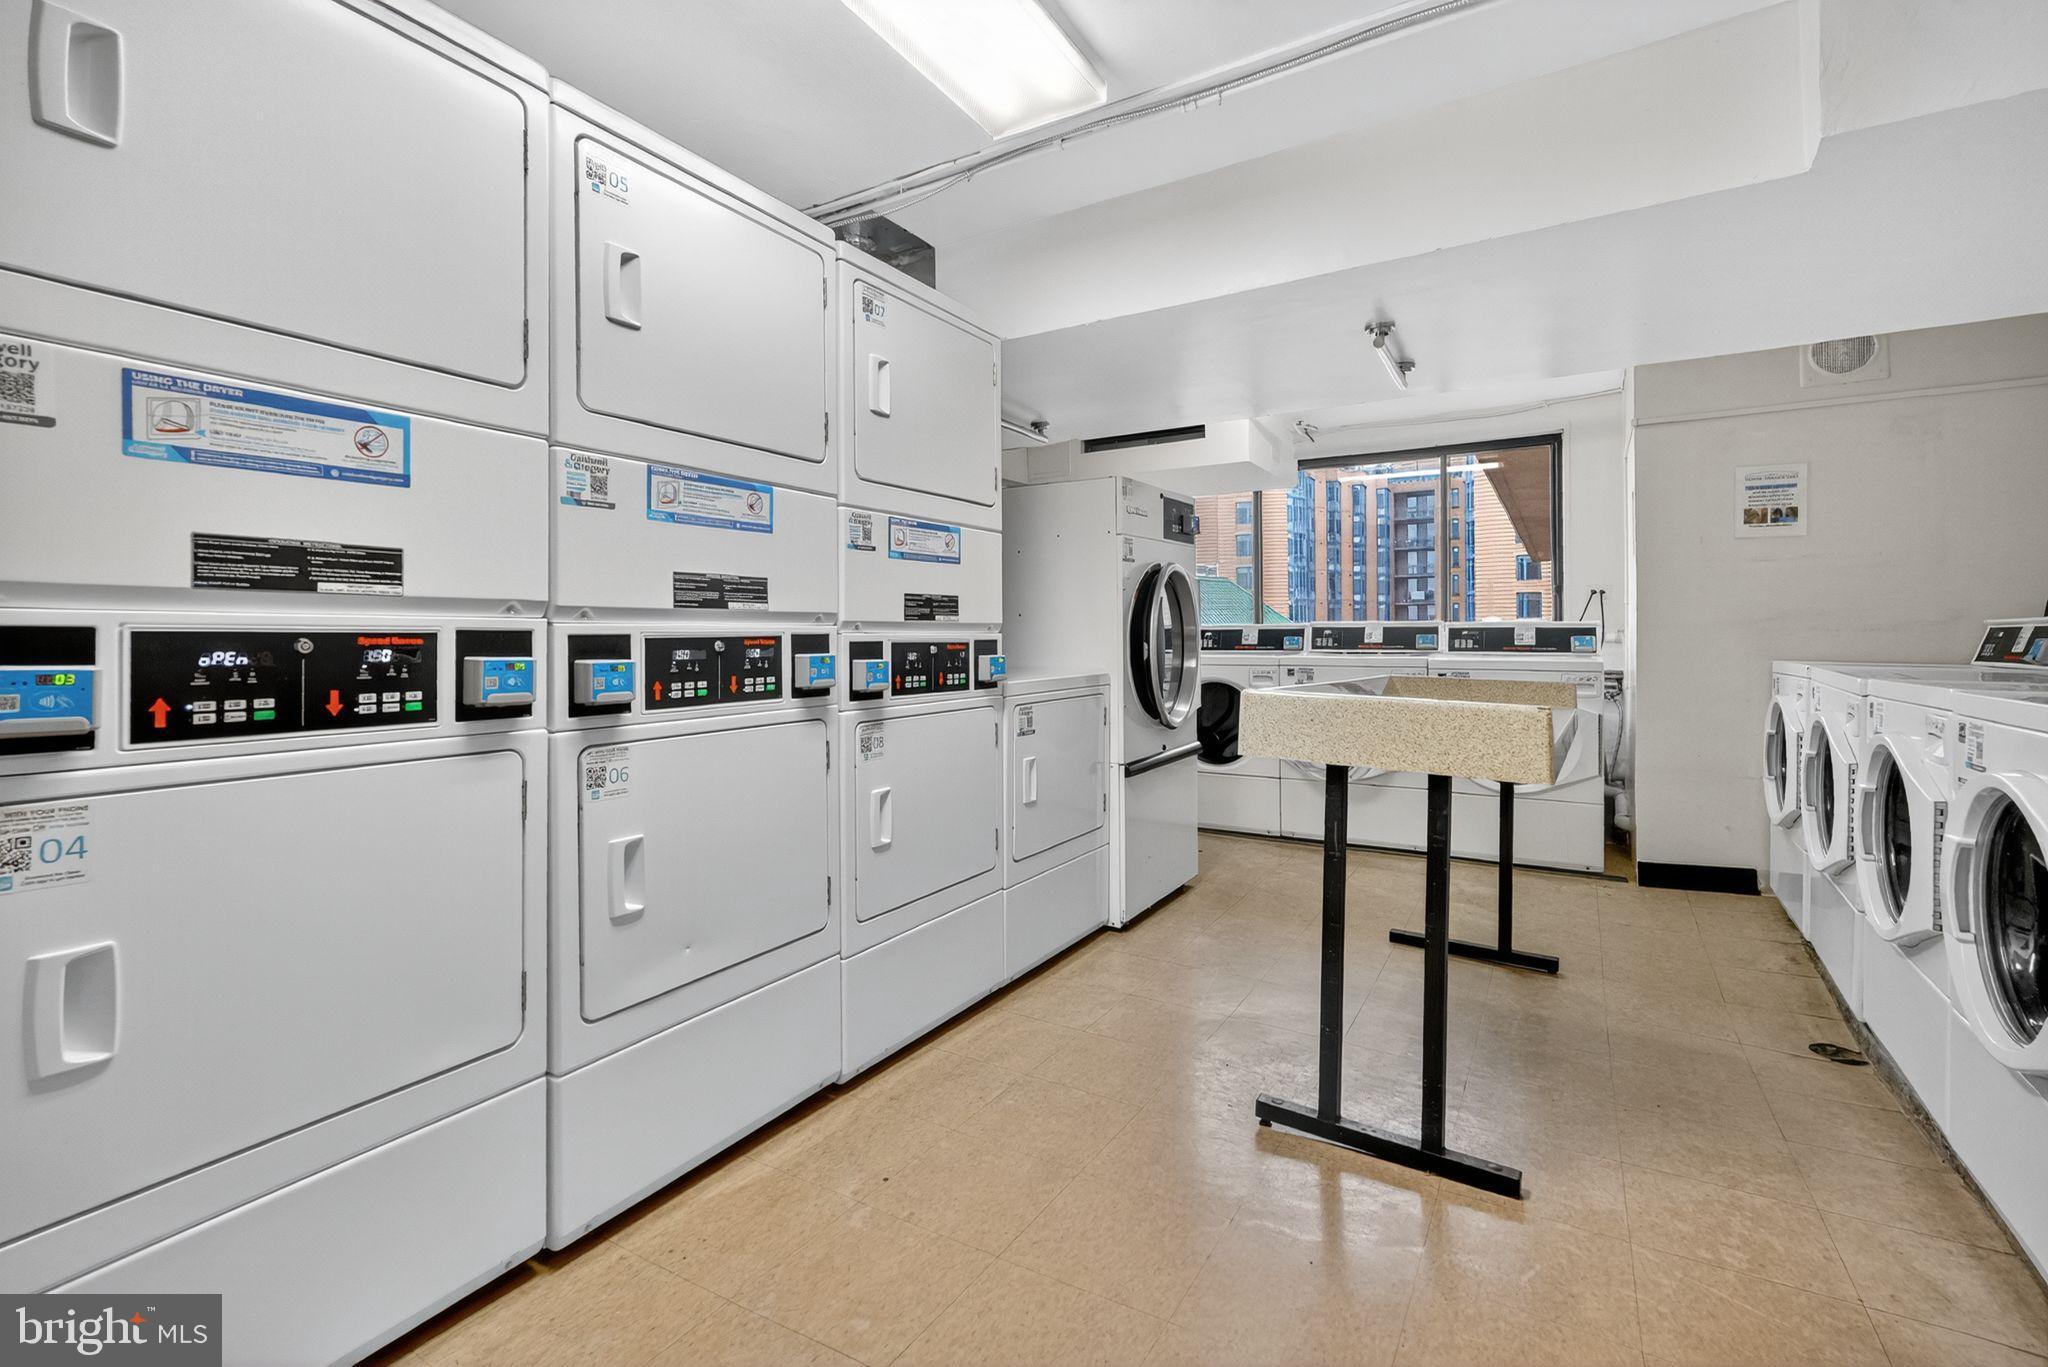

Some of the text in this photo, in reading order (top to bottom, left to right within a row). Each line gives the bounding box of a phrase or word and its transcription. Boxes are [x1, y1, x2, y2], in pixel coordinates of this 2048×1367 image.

[609, 172, 629, 193] 05
[874, 303, 885, 317] 07
[131, 371, 173, 385] USING
[175, 379, 201, 391] THE
[202, 383, 244, 397] DRYER
[873, 736, 885, 750] 08
[609, 766, 629, 784] 06
[39, 835, 89, 864] 04
